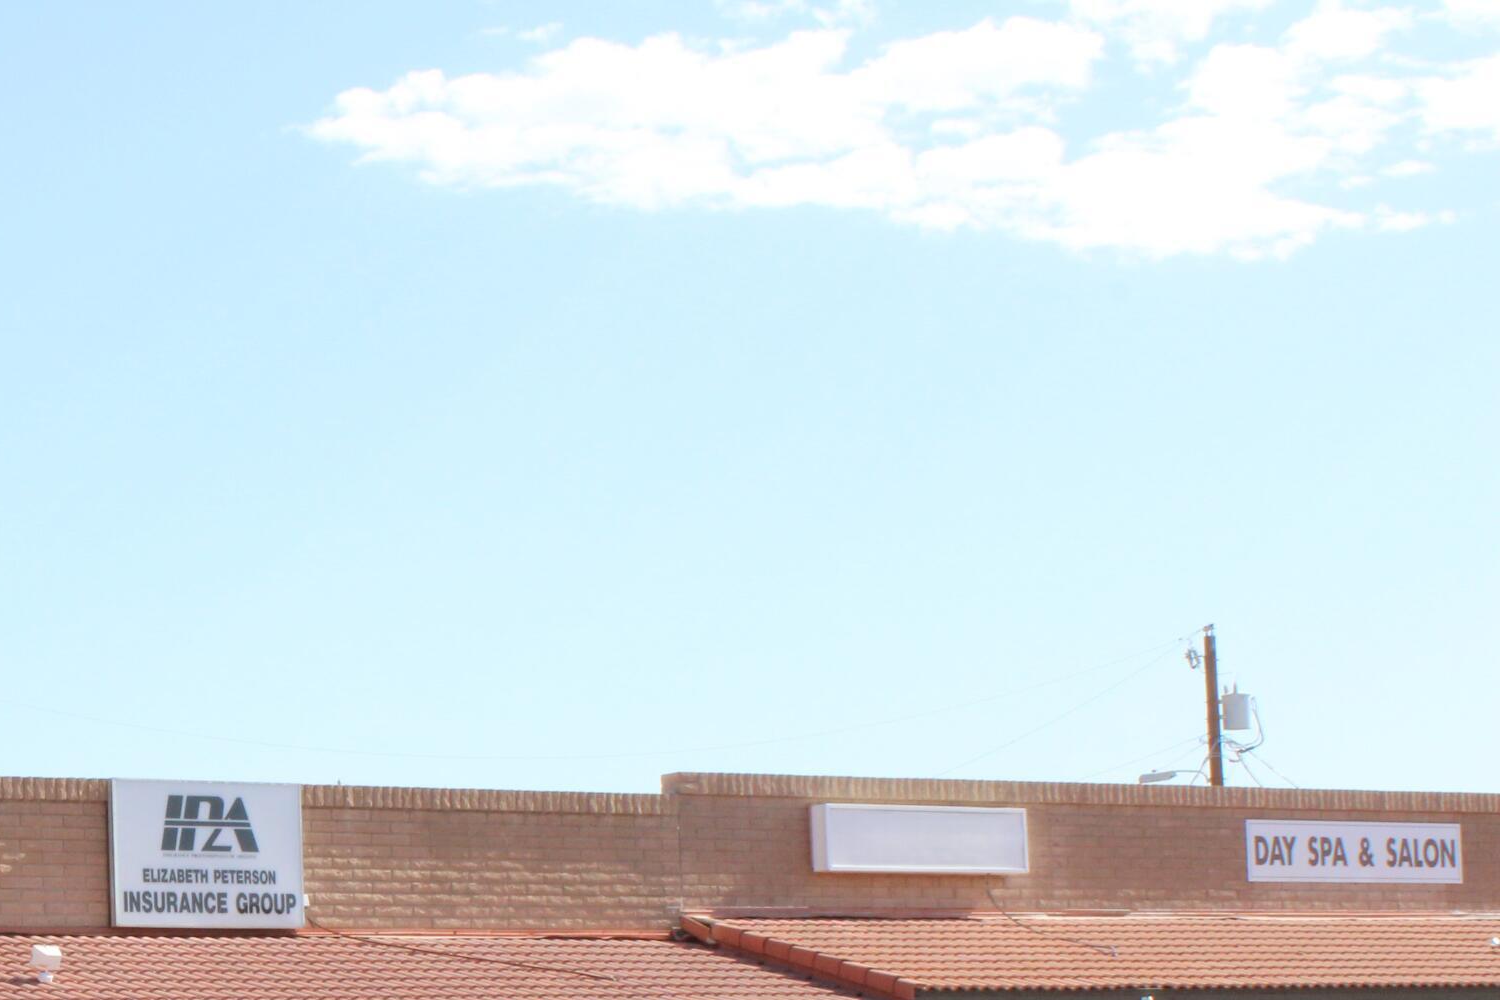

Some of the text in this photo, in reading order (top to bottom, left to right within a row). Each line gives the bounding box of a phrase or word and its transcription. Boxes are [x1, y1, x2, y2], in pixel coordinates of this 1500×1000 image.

[1254, 836, 1456, 868] DAY SPA & SALON
[142, 868, 276, 885] ELIZABETH PETERSON
[123, 891, 297, 914] INSURANCE GROUP
